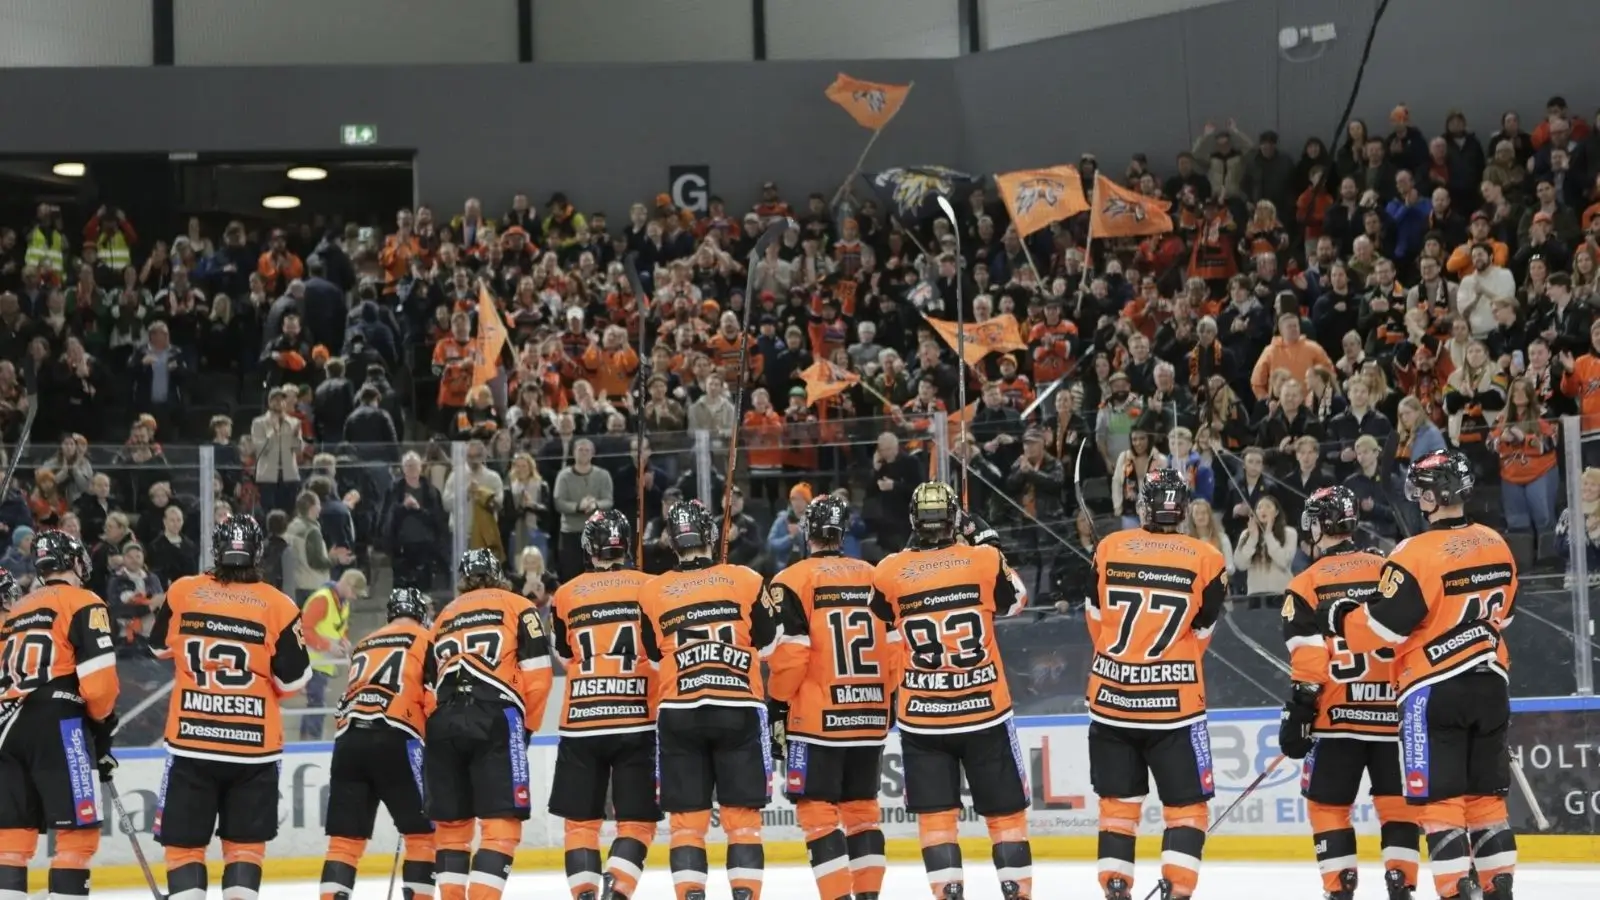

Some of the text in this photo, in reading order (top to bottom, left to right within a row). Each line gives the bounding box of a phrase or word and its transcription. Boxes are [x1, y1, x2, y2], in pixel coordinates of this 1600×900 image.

[672, 173, 708, 212] G
[1165, 490, 1176, 504] 77
[831, 506, 841, 517] 12
[609, 526, 620, 537] 14
[919, 558, 971, 572] energima
[1106, 568, 1192, 585] Orange Cyberdefens
[686, 606, 738, 620] Cyberdefens
[1107, 589, 1190, 660] 77
[576, 622, 639, 675] 14
[826, 609, 881, 679] 12
[903, 609, 988, 669] 83
[184, 637, 256, 690] 13
[722, 645, 751, 670] BYE
[1121, 663, 1196, 684] PEDERSEN
[183, 691, 263, 716] ANDRESEN
[908, 696, 991, 713] Dressmann
[1097, 688, 1177, 708] Dressmann
[569, 704, 646, 719] Dressmann
[180, 720, 263, 743] Dressmann
[71, 727, 93, 799] SpareBank
[1409, 777, 1424, 789] 1
[81, 804, 93, 816] 1
